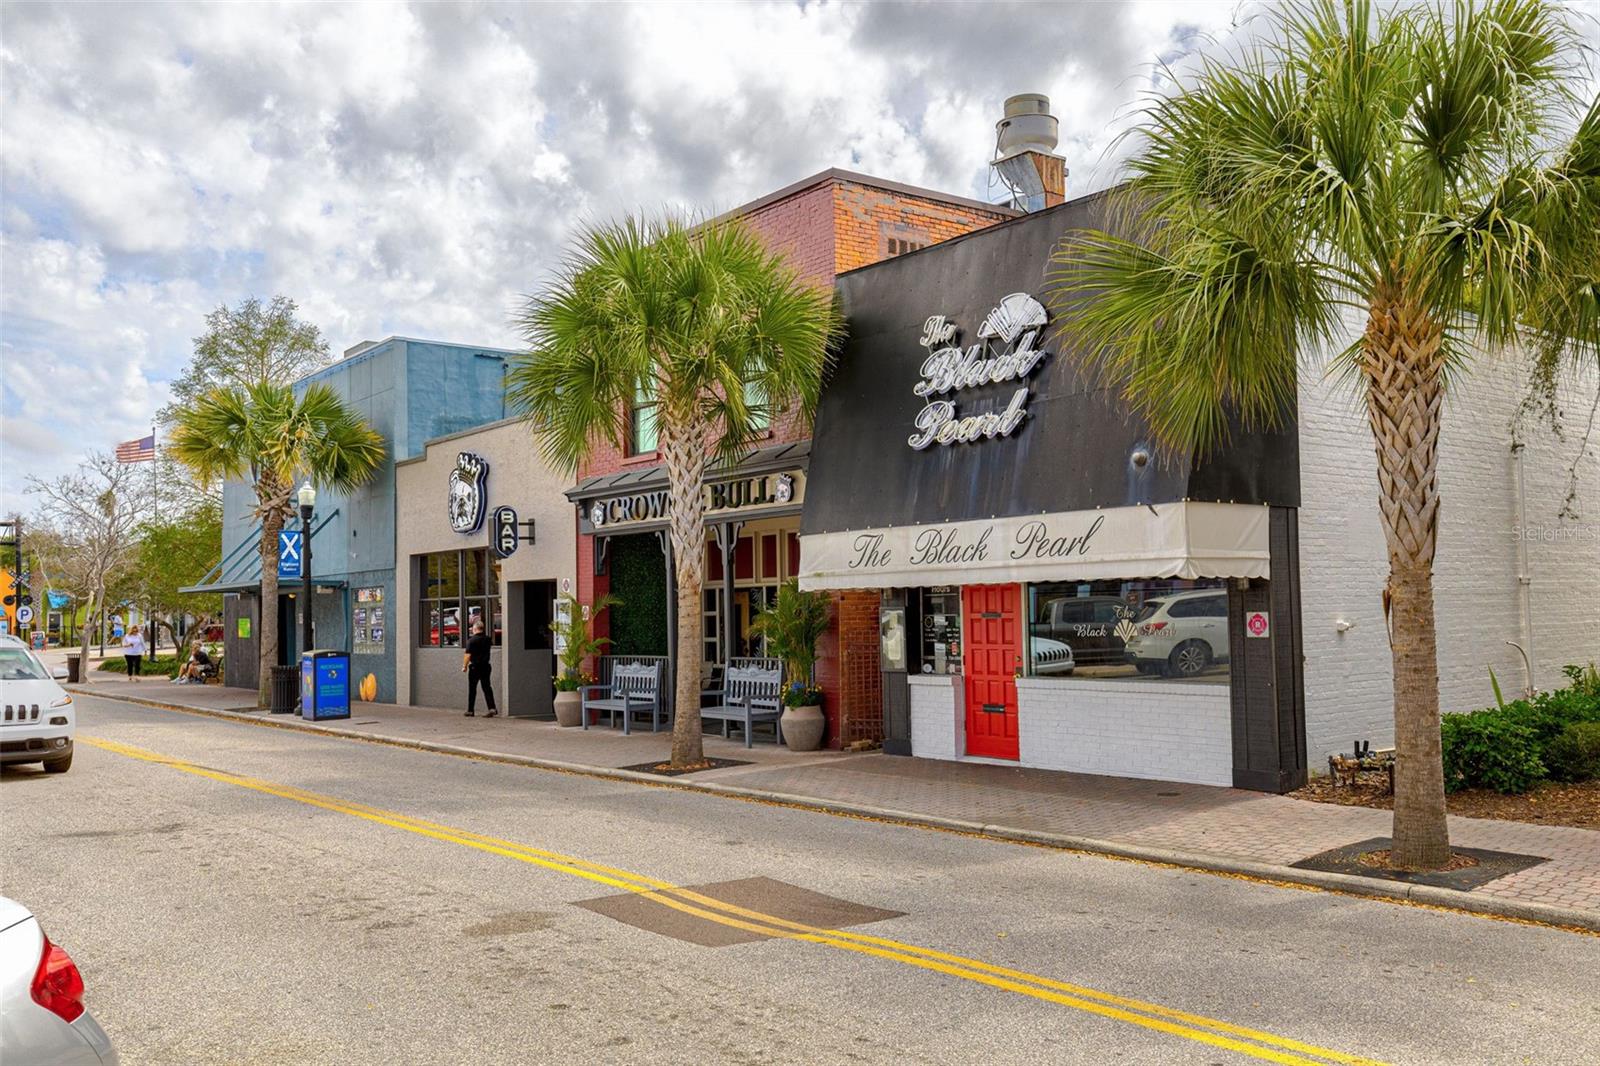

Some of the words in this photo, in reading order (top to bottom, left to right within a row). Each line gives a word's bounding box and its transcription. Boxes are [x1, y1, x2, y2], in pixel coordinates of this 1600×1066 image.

[919, 315, 957, 347] The
[913, 330, 1046, 397] Black
[907, 387, 1030, 451] Pearl
[606, 491, 673, 523] CROW
[709, 476, 776, 511] BULL
[500, 511, 515, 551] BAR
[848, 533, 892, 568] The
[909, 525, 995, 565] Black
[1010, 515, 1105, 560] Pearl
[20, 609, 29, 620] P
[1073, 624, 1108, 637] Black
[1112, 605, 1136, 619] The
